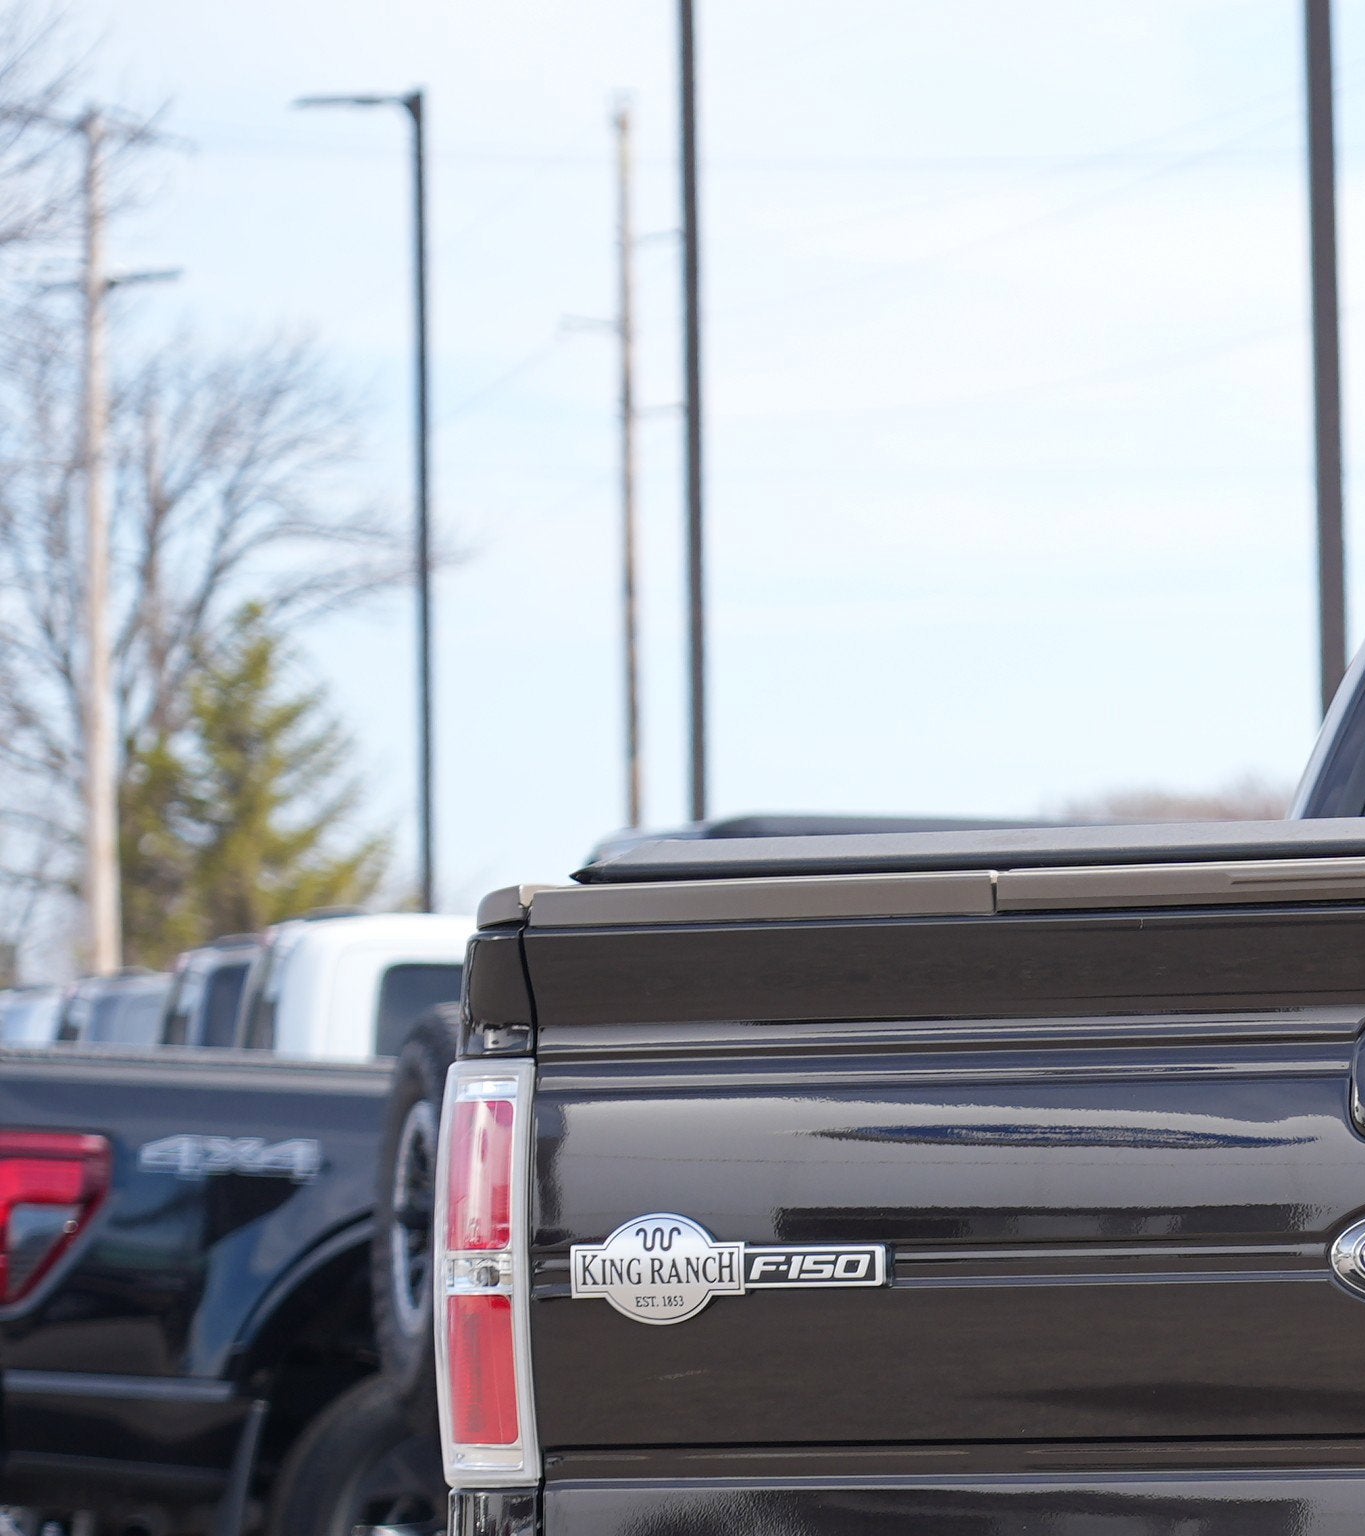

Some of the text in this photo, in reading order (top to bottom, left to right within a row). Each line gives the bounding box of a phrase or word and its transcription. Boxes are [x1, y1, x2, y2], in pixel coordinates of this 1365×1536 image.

[581, 1251, 736, 1286] KING RANCH
[750, 1254, 871, 1280] F-150
[635, 1295, 684, 1308] EST. 1853
